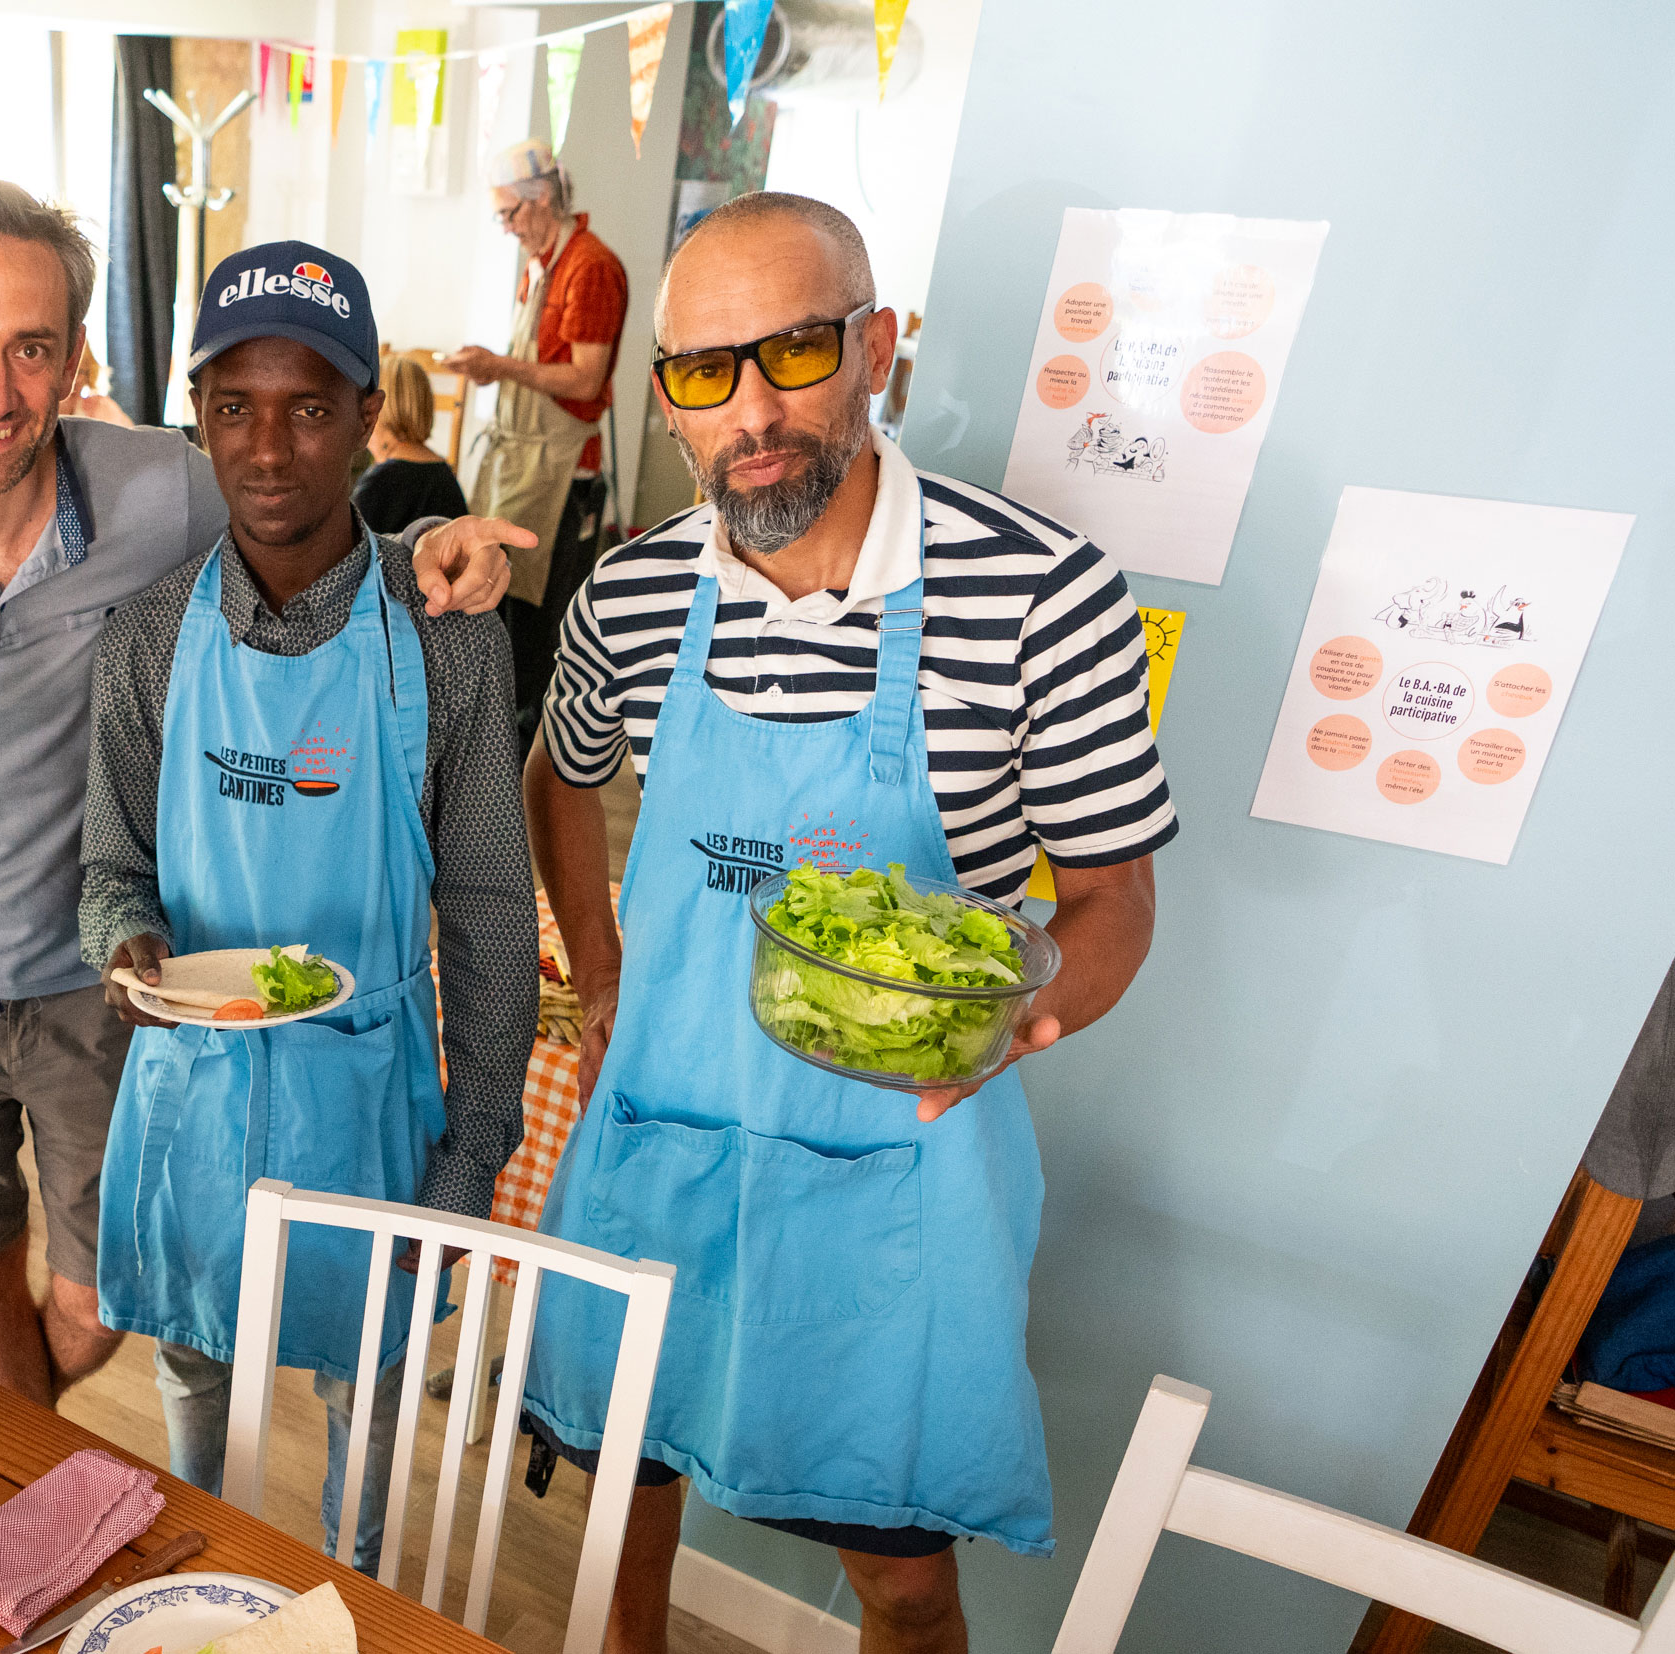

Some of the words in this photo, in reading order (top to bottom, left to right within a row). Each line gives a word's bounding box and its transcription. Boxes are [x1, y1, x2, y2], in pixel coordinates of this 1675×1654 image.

[218, 267, 350, 319] ellesse
[1065, 298, 1092, 308] Adopter
[1065, 308, 1091, 317] position
[1070, 317, 1092, 325] travail
[1044, 367, 1076, 377] Respecter
[1203, 366, 1245, 377] Rassembler
[1070, 378, 1077, 386] la
[1201, 375, 1230, 384] matériel
[1203, 385, 1243, 395] ingrédients
[1189, 391, 1230, 403] nécessaires
[1203, 403, 1244, 413] commencer
[1202, 411, 1244, 422] préparation
[1319, 647, 1344, 658] Utiliser
[1345, 652, 1358, 660] des
[1316, 665, 1345, 675] coupure
[1356, 671, 1374, 679] pour
[1315, 673, 1351, 684] manipuler
[1362, 679, 1370, 687] la
[1328, 683, 1352, 692] viande
[1399, 676, 1411, 689] Le
[1452, 684, 1467, 697] de
[1535, 686, 1547, 694] les
[1402, 691, 1413, 703] la
[1415, 695, 1453, 710] cuisine
[1390, 704, 1457, 725] participative
[1313, 727, 1324, 735] Ne
[1324, 729, 1348, 740] jamais
[1349, 734, 1370, 744] poser
[1311, 744, 1328, 753] dans
[1329, 746, 1337, 754] la
[1351, 743, 1366, 751] sale
[1469, 739, 1504, 751] Travailler
[1504, 746, 1523, 754] avec
[220, 745, 238, 766] LES
[239, 752, 287, 775] PETITES
[1481, 750, 1517, 761] minuteur
[1393, 758, 1417, 768] Porter
[1417, 763, 1431, 771] des
[1476, 758, 1495, 767] pour
[1495, 759, 1503, 768] la
[219, 771, 285, 806] CANTINES
[1385, 782, 1408, 792] même
[706, 832, 728, 852] LES
[731, 836, 784, 864] PETITES
